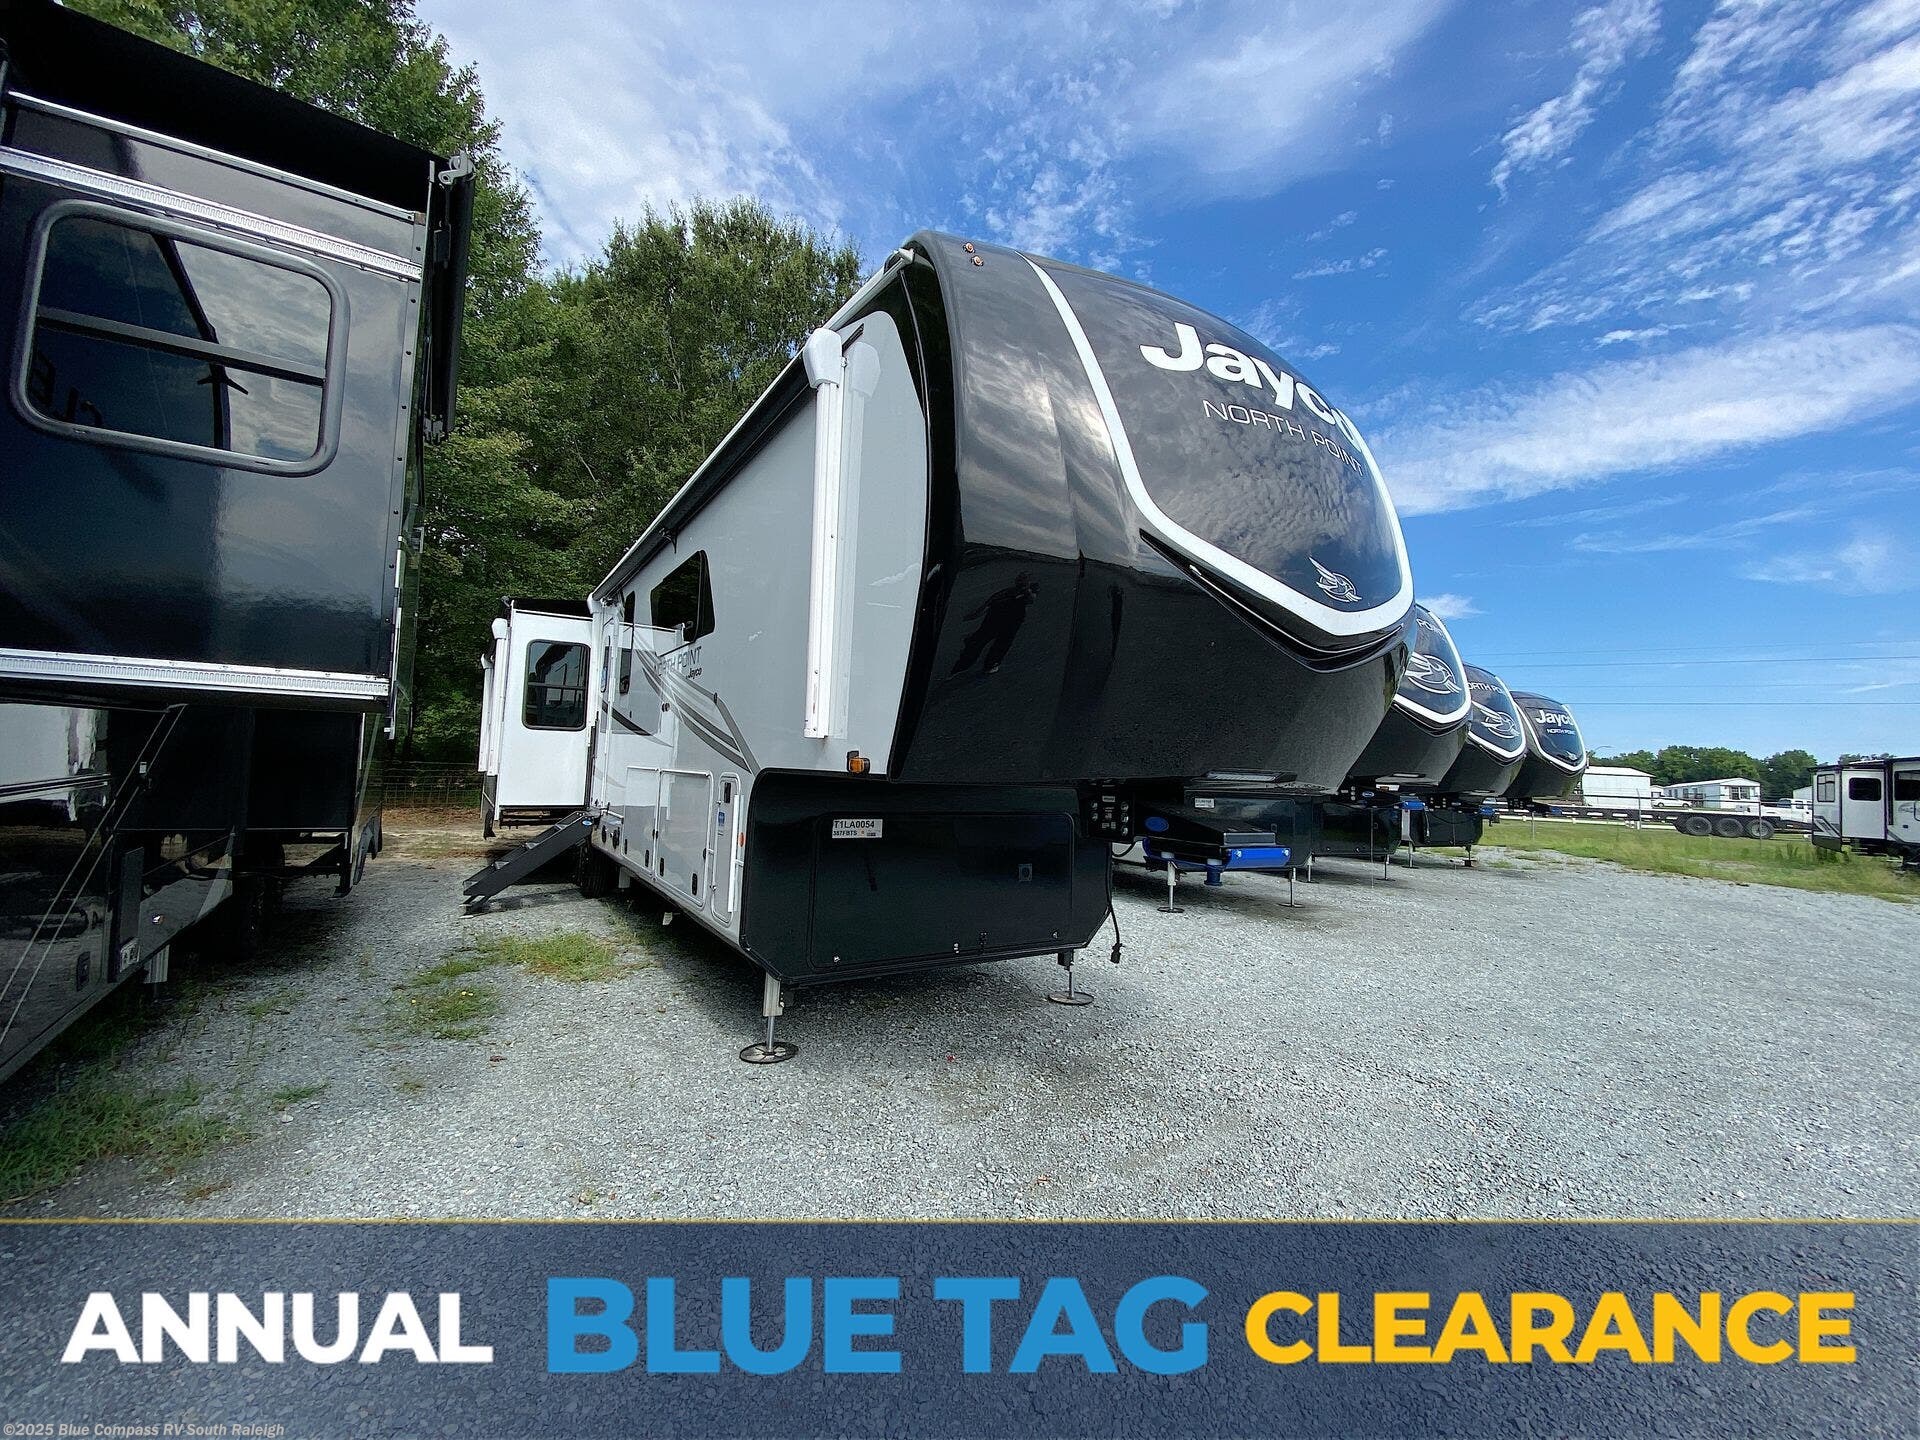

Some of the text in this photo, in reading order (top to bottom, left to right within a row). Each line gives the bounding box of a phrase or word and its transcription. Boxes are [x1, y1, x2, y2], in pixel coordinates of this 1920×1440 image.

[1140, 322, 1362, 453] Jayco
[1202, 400, 1364, 476] NORTH POINT
[1466, 682, 1492, 691] ORTH
[834, 820, 875, 829] T1LA0054
